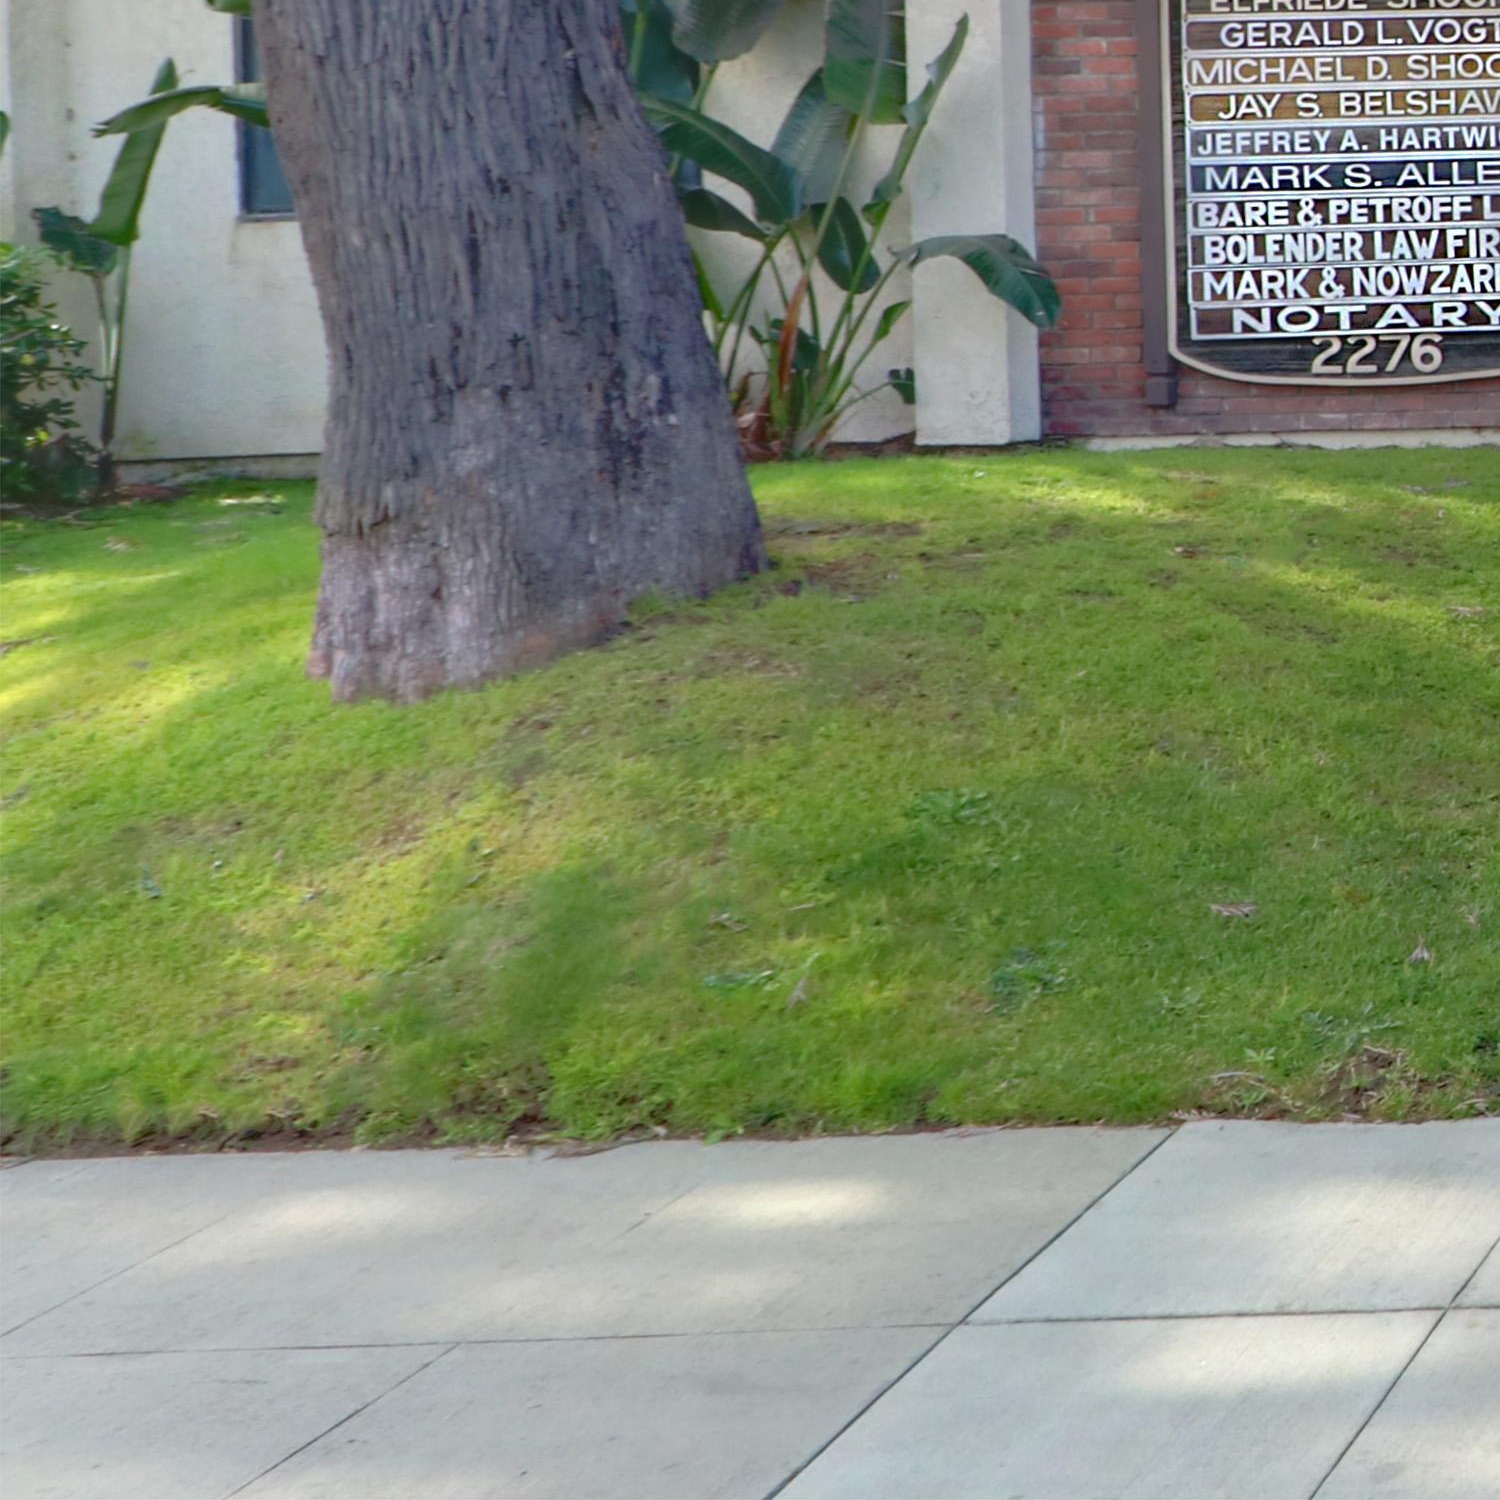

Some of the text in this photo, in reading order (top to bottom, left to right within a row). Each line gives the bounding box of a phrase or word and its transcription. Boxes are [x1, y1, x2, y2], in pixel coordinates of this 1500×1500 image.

[1220, 21, 1365, 47] GERALD
[1191, 57, 1355, 84] MICHAEL
[1366, 56, 1392, 80] D.
[1218, 94, 1281, 120] JAY
[1296, 93, 1324, 118] S.
[1198, 130, 1331, 155] JEFFREY
[1340, 129, 1368, 151] A.
[1205, 164, 1332, 190] MARK
[1344, 164, 1382, 187] S.
[1197, 201, 1289, 227] BARE
[1297, 197, 1323, 226] &
[1329, 195, 1473, 224] PETROFF
[1204, 232, 1364, 264] BOLENDER
[1373, 230, 1439, 260] LAW
[1203, 268, 1310, 300] MARK
[1318, 267, 1345, 298] &
[1311, 333, 1444, 374] 2276
